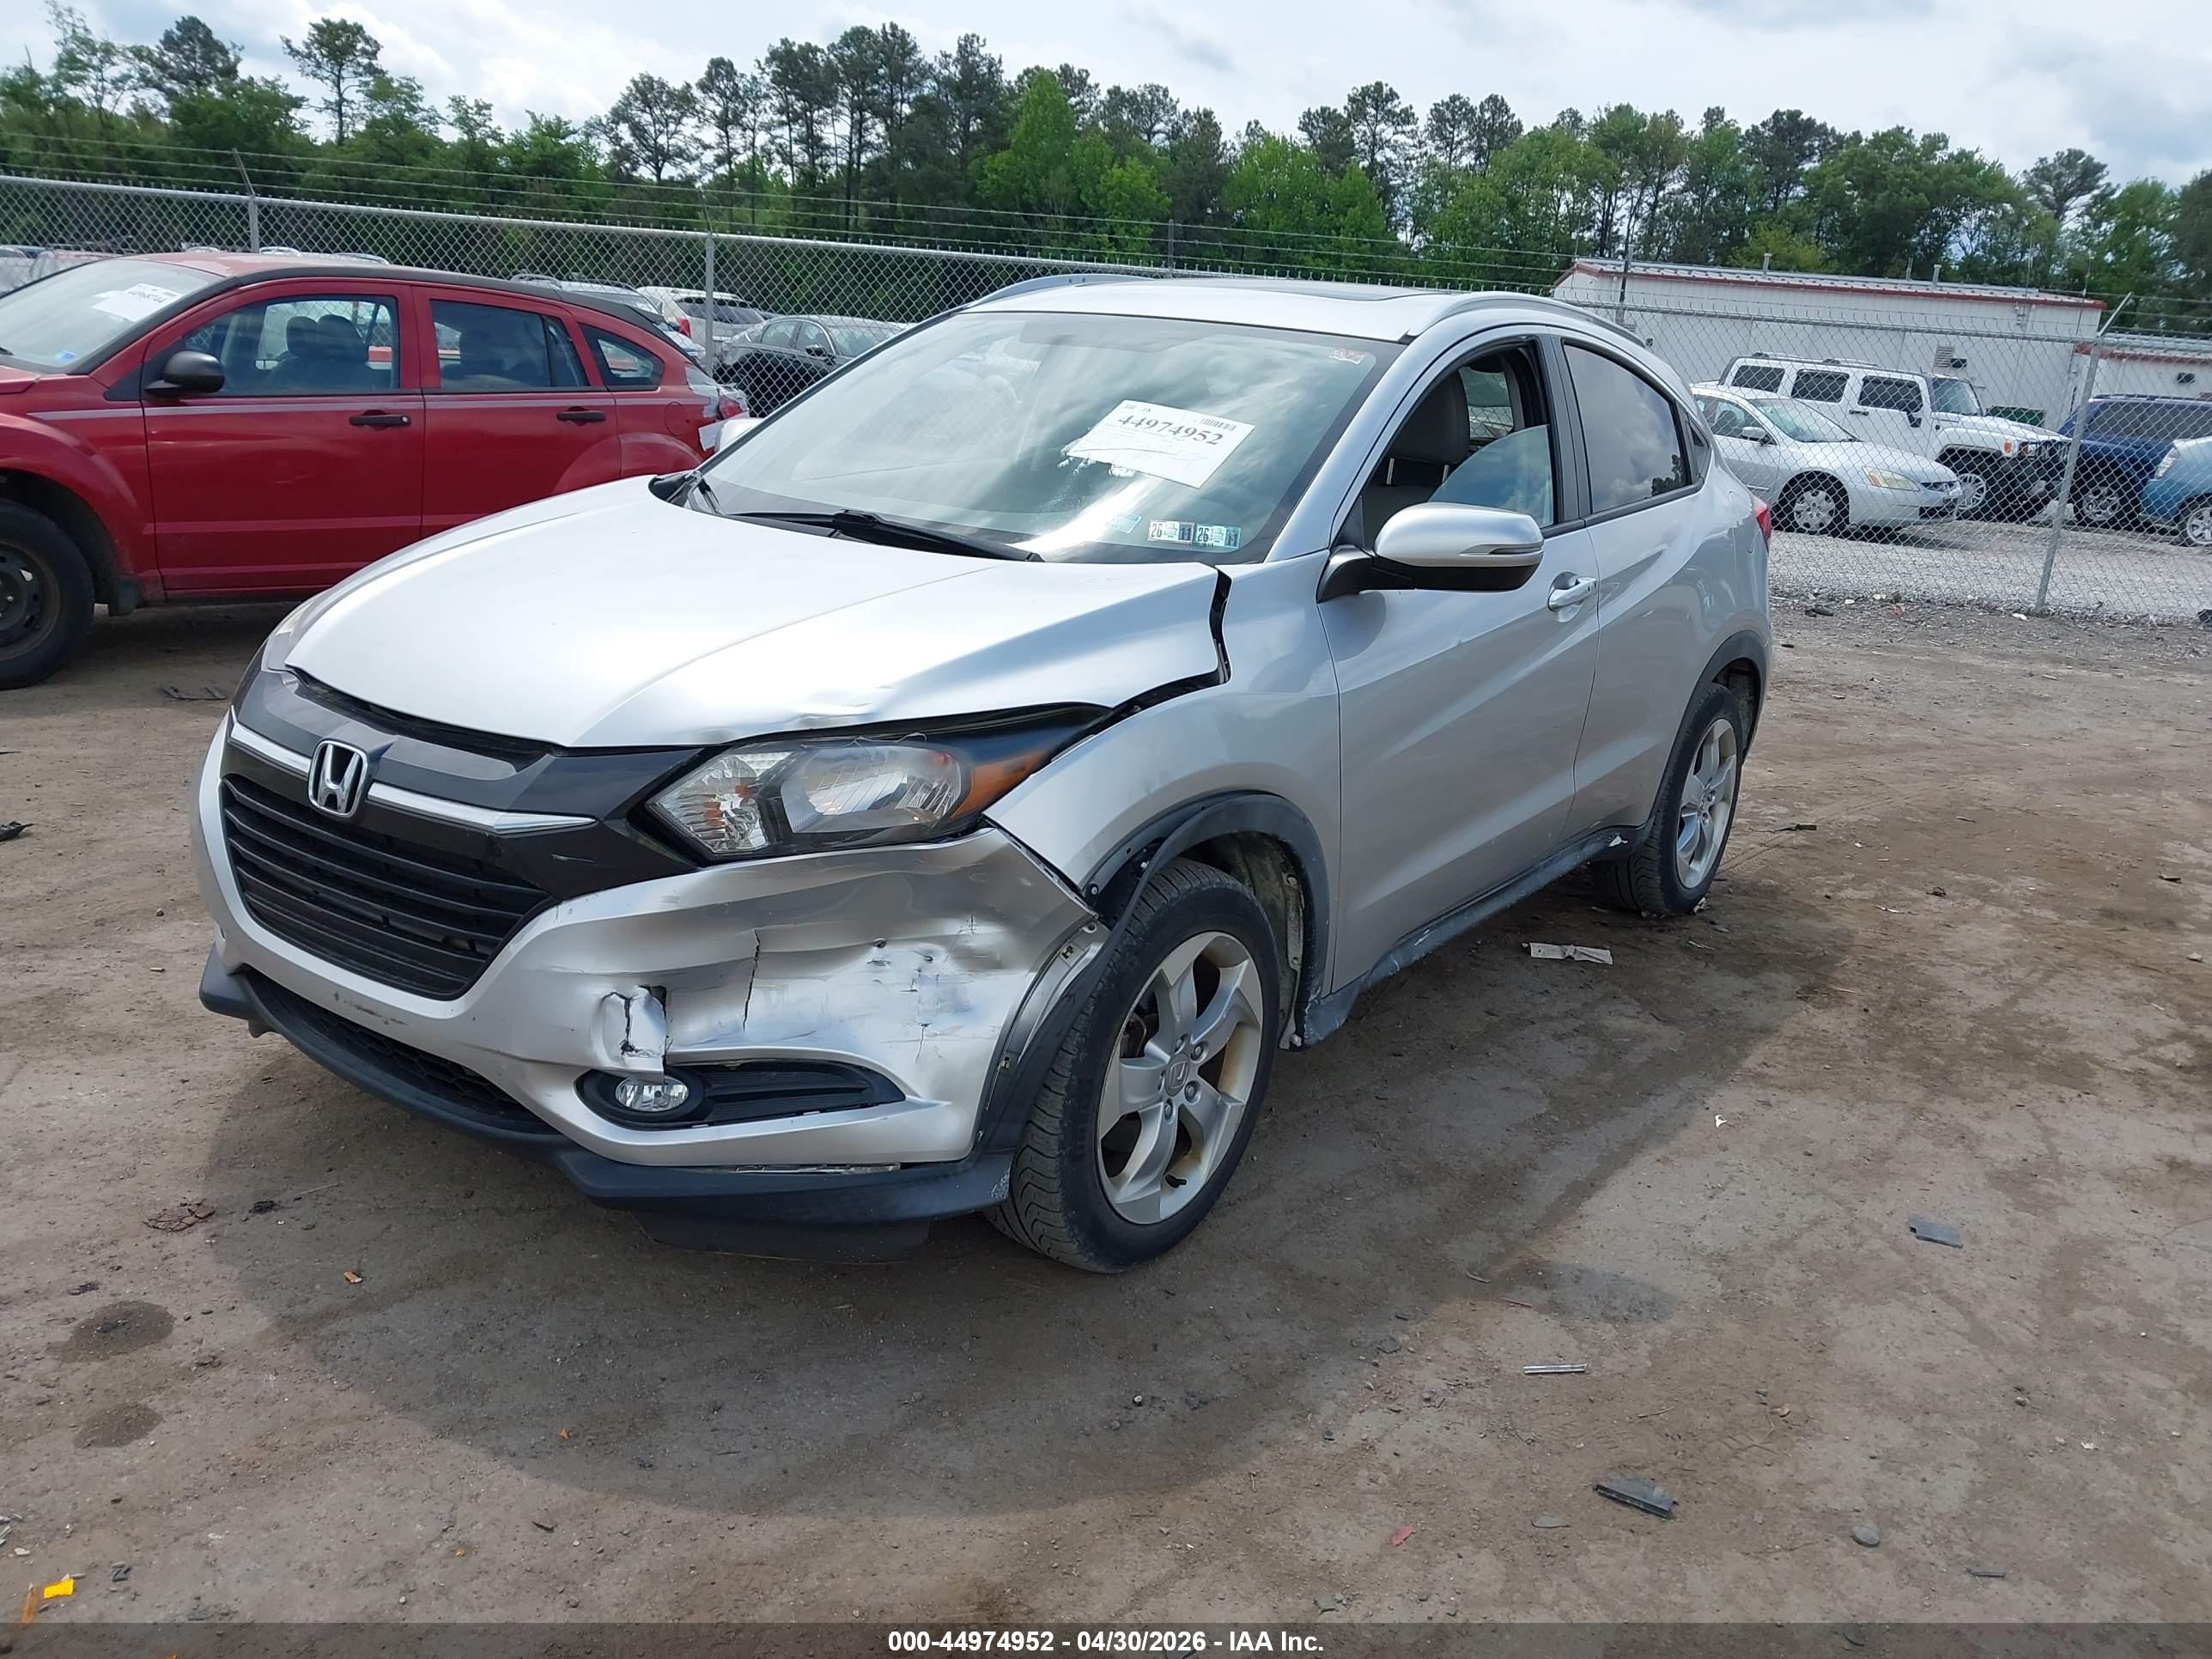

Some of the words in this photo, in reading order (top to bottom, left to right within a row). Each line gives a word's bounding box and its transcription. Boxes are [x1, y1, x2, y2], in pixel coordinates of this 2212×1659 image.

[1117, 415, 1223, 445] 44974952
[1152, 523, 1163, 538] 26
[1198, 527, 1210, 543] 26
